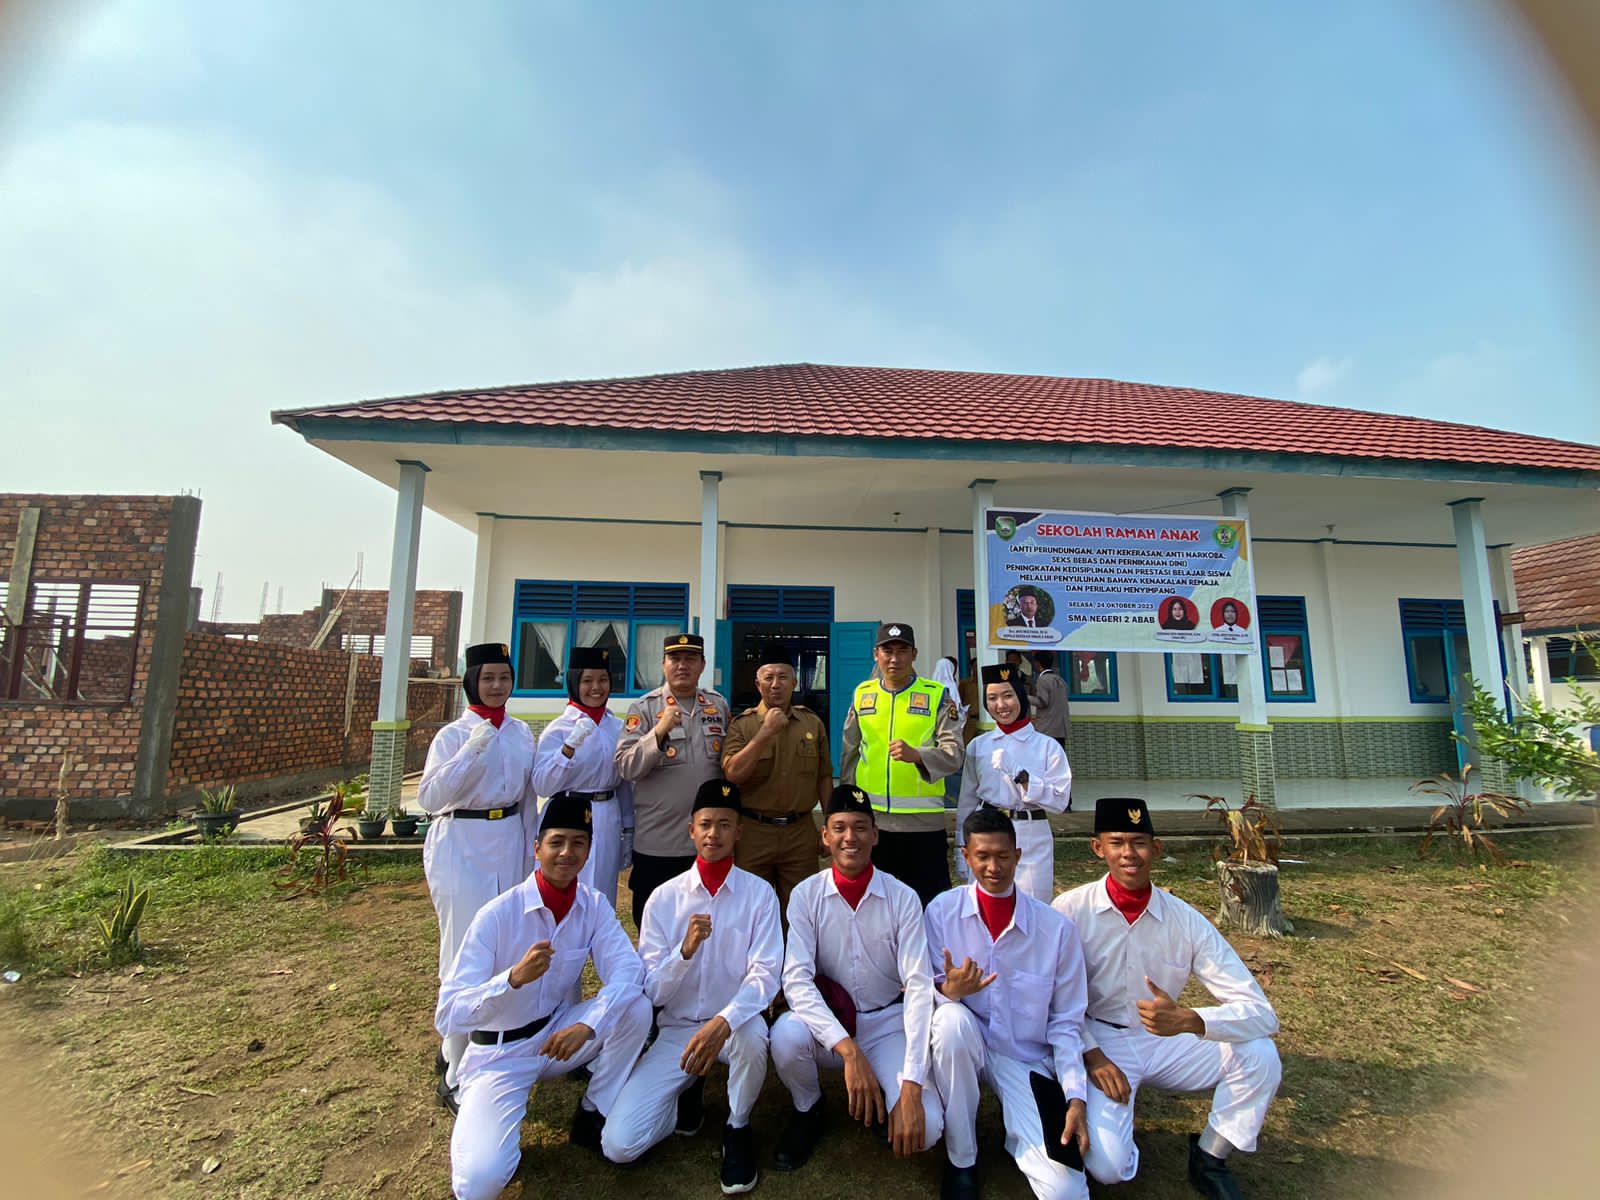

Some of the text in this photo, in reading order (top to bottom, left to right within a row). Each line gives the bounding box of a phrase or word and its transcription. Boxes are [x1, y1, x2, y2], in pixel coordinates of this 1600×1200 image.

[1037, 524, 1200, 541] SEKOLAH RAMAH ANAK
[1096, 548, 1116, 556] ANTI
[1006, 564, 1061, 572] PENINGKATAN
[1062, 566, 1114, 574] KEDISIPLINAN
[1054, 575, 1105, 583] PENYULUHAN
[1068, 614, 1088, 622] SMA
[1089, 615, 1122, 623] NEGERI
